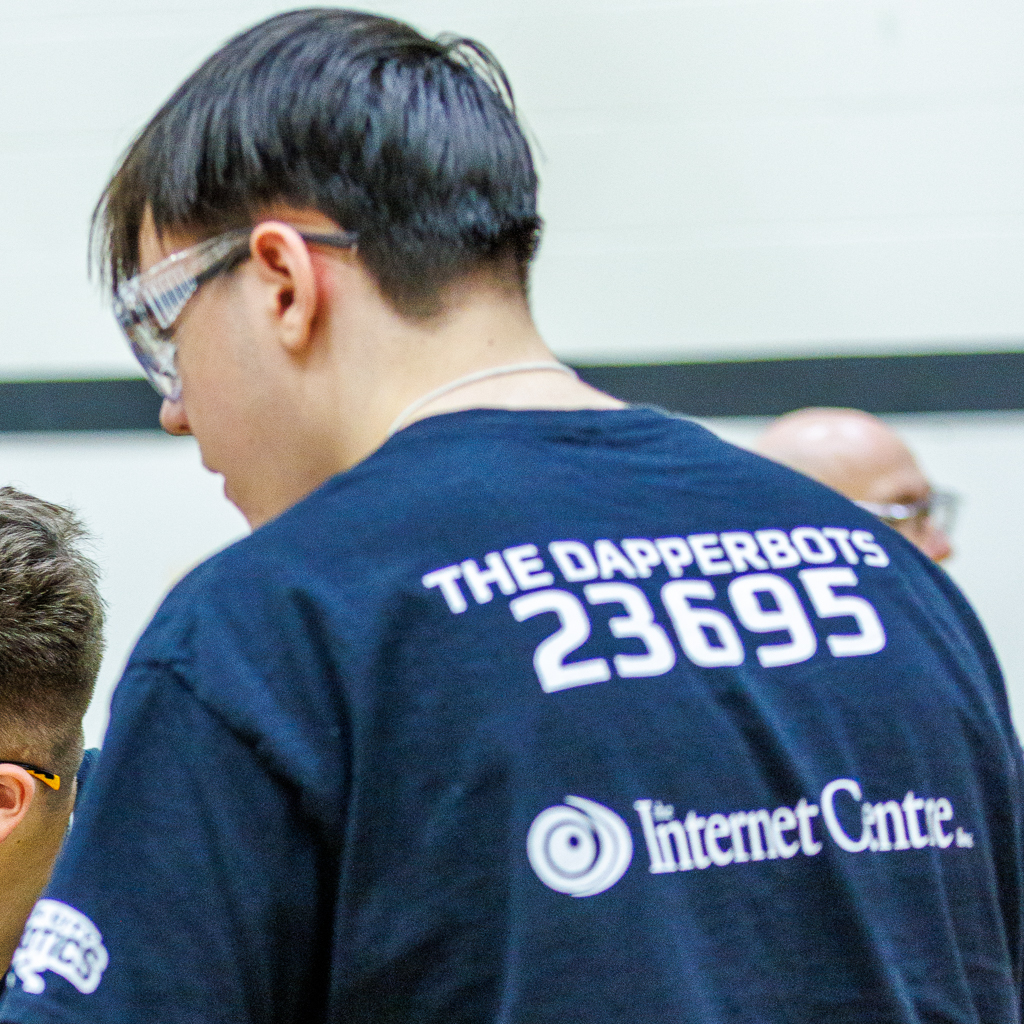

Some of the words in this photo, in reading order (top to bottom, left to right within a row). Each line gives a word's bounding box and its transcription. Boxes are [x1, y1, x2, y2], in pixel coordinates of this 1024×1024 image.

[423, 544, 554, 613] THE
[549, 527, 889, 582] DAPPERBOTS
[509, 567, 886, 693] 23695
[633, 798, 822, 874] Internet
